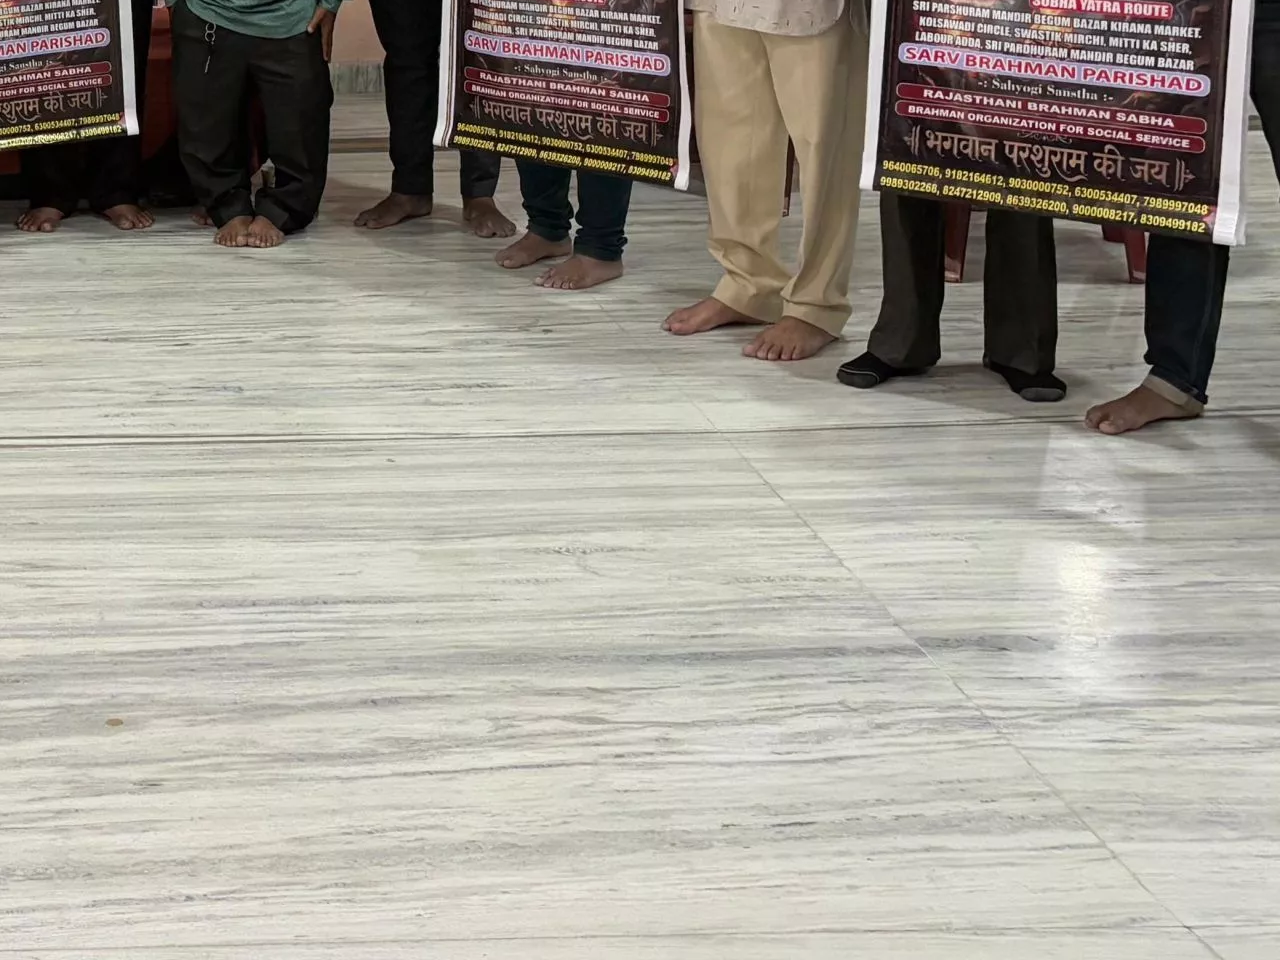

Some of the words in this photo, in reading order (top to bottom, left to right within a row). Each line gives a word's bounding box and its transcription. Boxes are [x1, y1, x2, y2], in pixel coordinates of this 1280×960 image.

[1125, 1, 1167, 16] ROUTE
[30, 31, 105, 52] PARISHAD
[467, 34, 499, 50] SARV
[504, 39, 580, 61] BRAHMAN
[586, 49, 664, 72] PARISHAD
[904, 46, 962, 65] SARV
[961, 53, 1078, 80] BRAHMAN
[1083, 65, 1200, 93] PARISHAD
[908, 105, 964, 119] BRAHMAN
[967, 112, 1055, 131] ORGANIZATION
[1059, 123, 1084, 134] FOR
[1087, 126, 1130, 140] SOCIAL
[1135, 133, 1189, 148] SERVICE
[922, 89, 1023, 109] RAJASTHANI
[1027, 101, 1110, 120] BRAHMAN
[1117, 111, 1174, 127] SABHA
[924, 128, 998, 164] भगवान
[1004, 140, 1088, 182] परशुराम
[1092, 143, 1125, 181] की
[1127, 156, 1172, 189] जय
